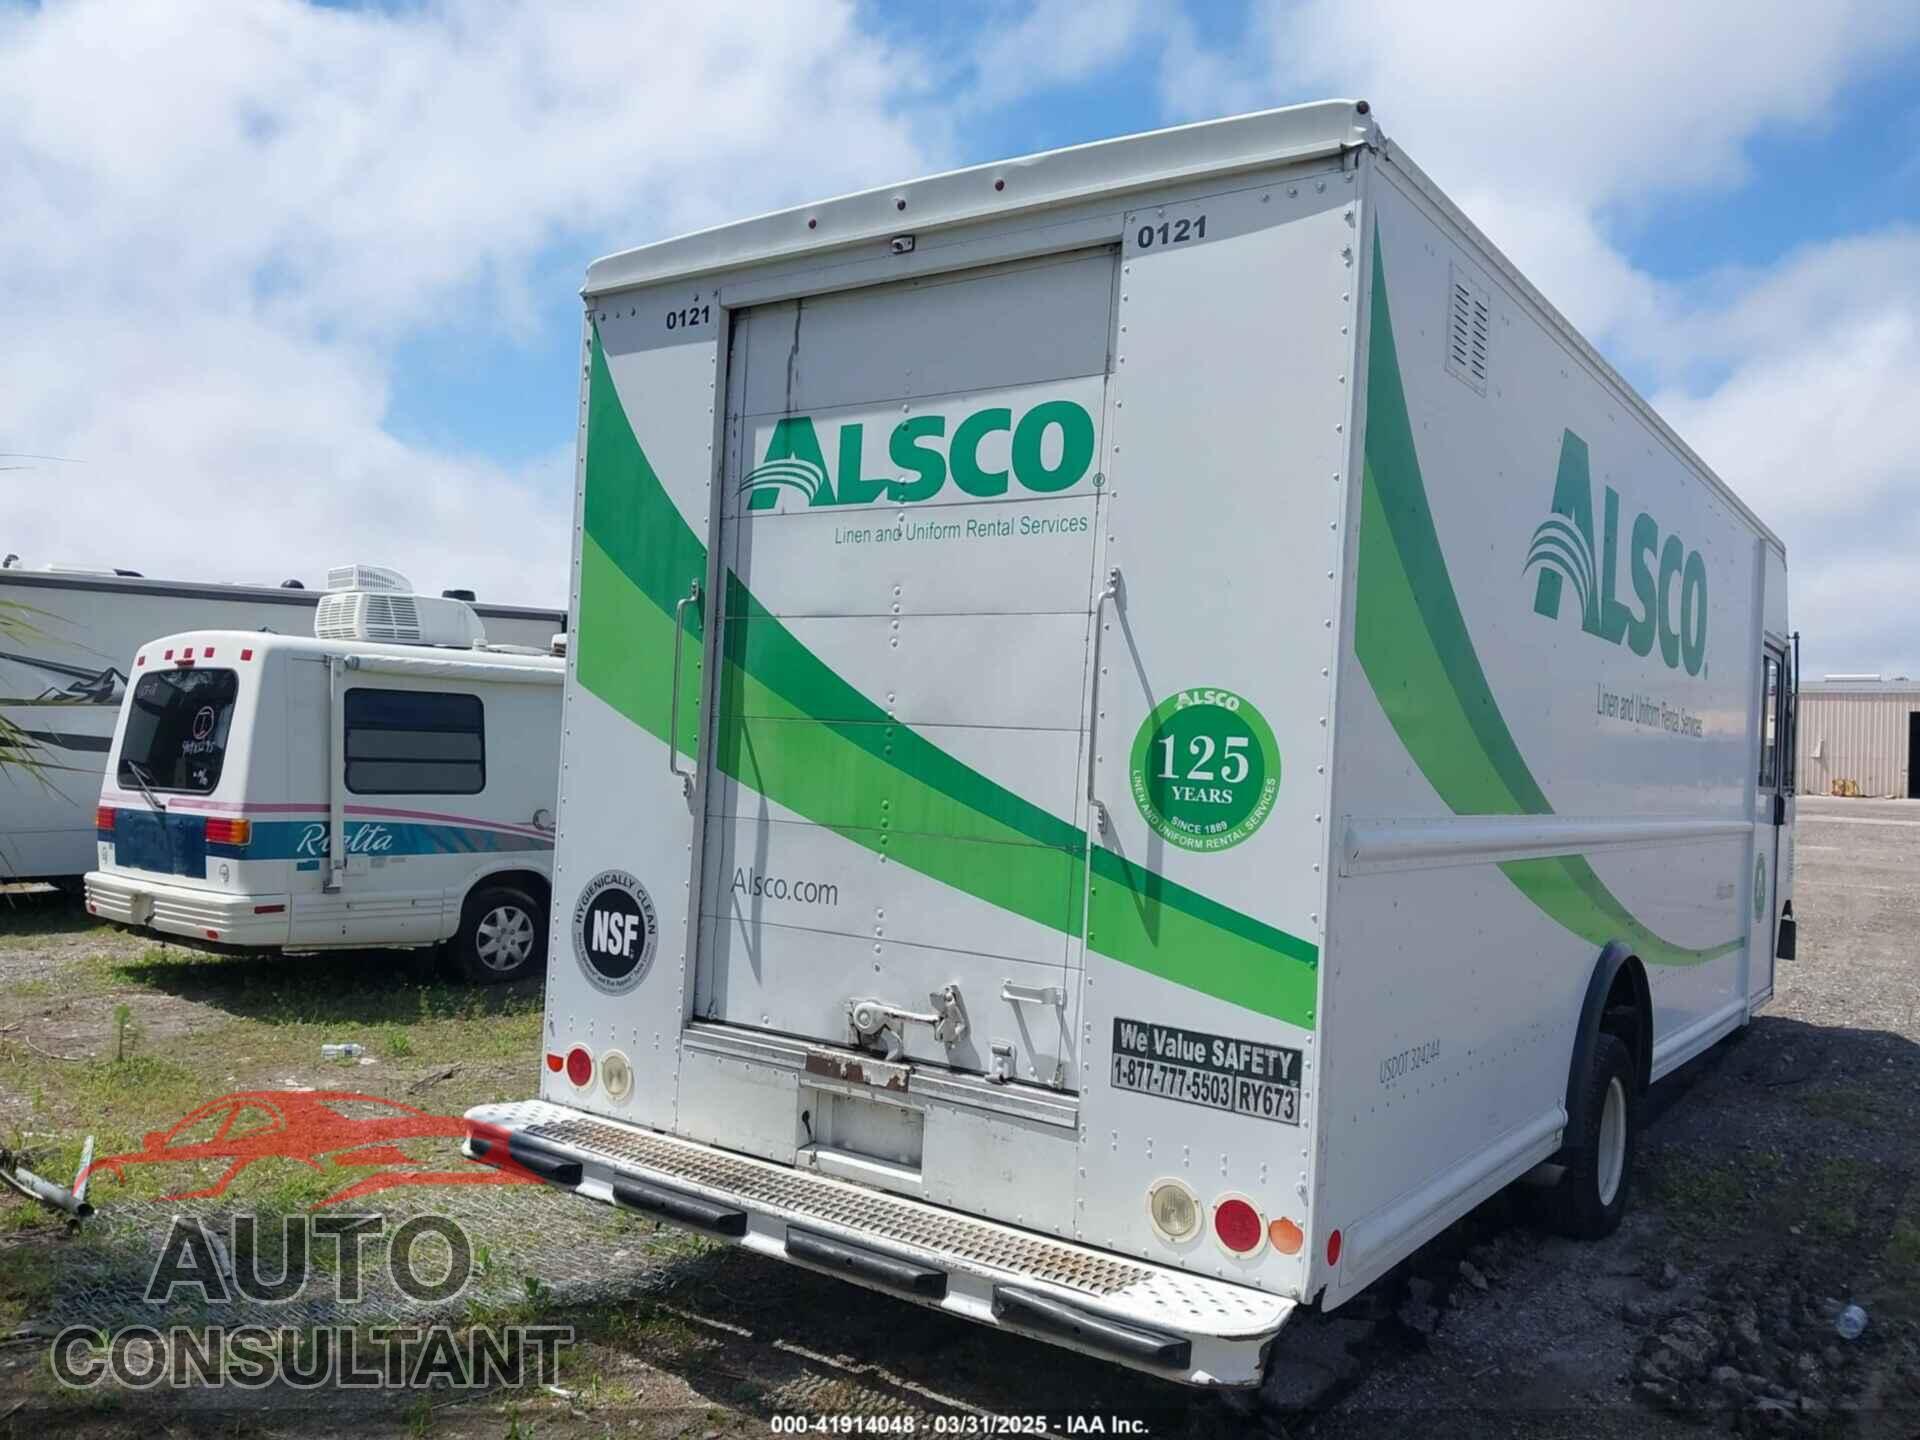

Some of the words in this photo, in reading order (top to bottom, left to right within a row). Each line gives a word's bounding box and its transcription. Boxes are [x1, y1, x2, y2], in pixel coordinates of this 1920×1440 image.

[1137, 214, 1207, 249] 0121
[666, 304, 710, 330] 0121
[736, 399, 1095, 511] ALSCO
[834, 527, 872, 545] Linen
[875, 525, 902, 543] and
[905, 522, 961, 542] Uniform
[966, 517, 1015, 537] Rental
[1019, 514, 1088, 535] Services
[1522, 427, 1708, 677] ALSCO
[1175, 690, 1241, 712] ALSCO
[1157, 734, 1250, 784] 125
[1158, 822, 1203, 849] UNIFORM
[1206, 826, 1245, 849] RENTAL
[1246, 777, 1277, 831] SERVICES
[1171, 786, 1233, 805] YEARS
[1170, 816, 1201, 835] SINCE
[1205, 820, 1229, 835] 1889
[575, 873, 636, 924] HYGIENICALLY
[636, 888, 657, 936] CLEAN
[730, 866, 839, 906] Alsco.com
[591, 909, 640, 958] NSF
[1120, 1021, 1148, 1052] We
[1153, 1027, 1206, 1064] Value
[1212, 1039, 1293, 1079] SAFETY
[1379, 1050, 1408, 1084] USDOT
[1115, 1055, 1230, 1107] 1-877-777-5503
[1239, 1080, 1295, 1120] RY673
